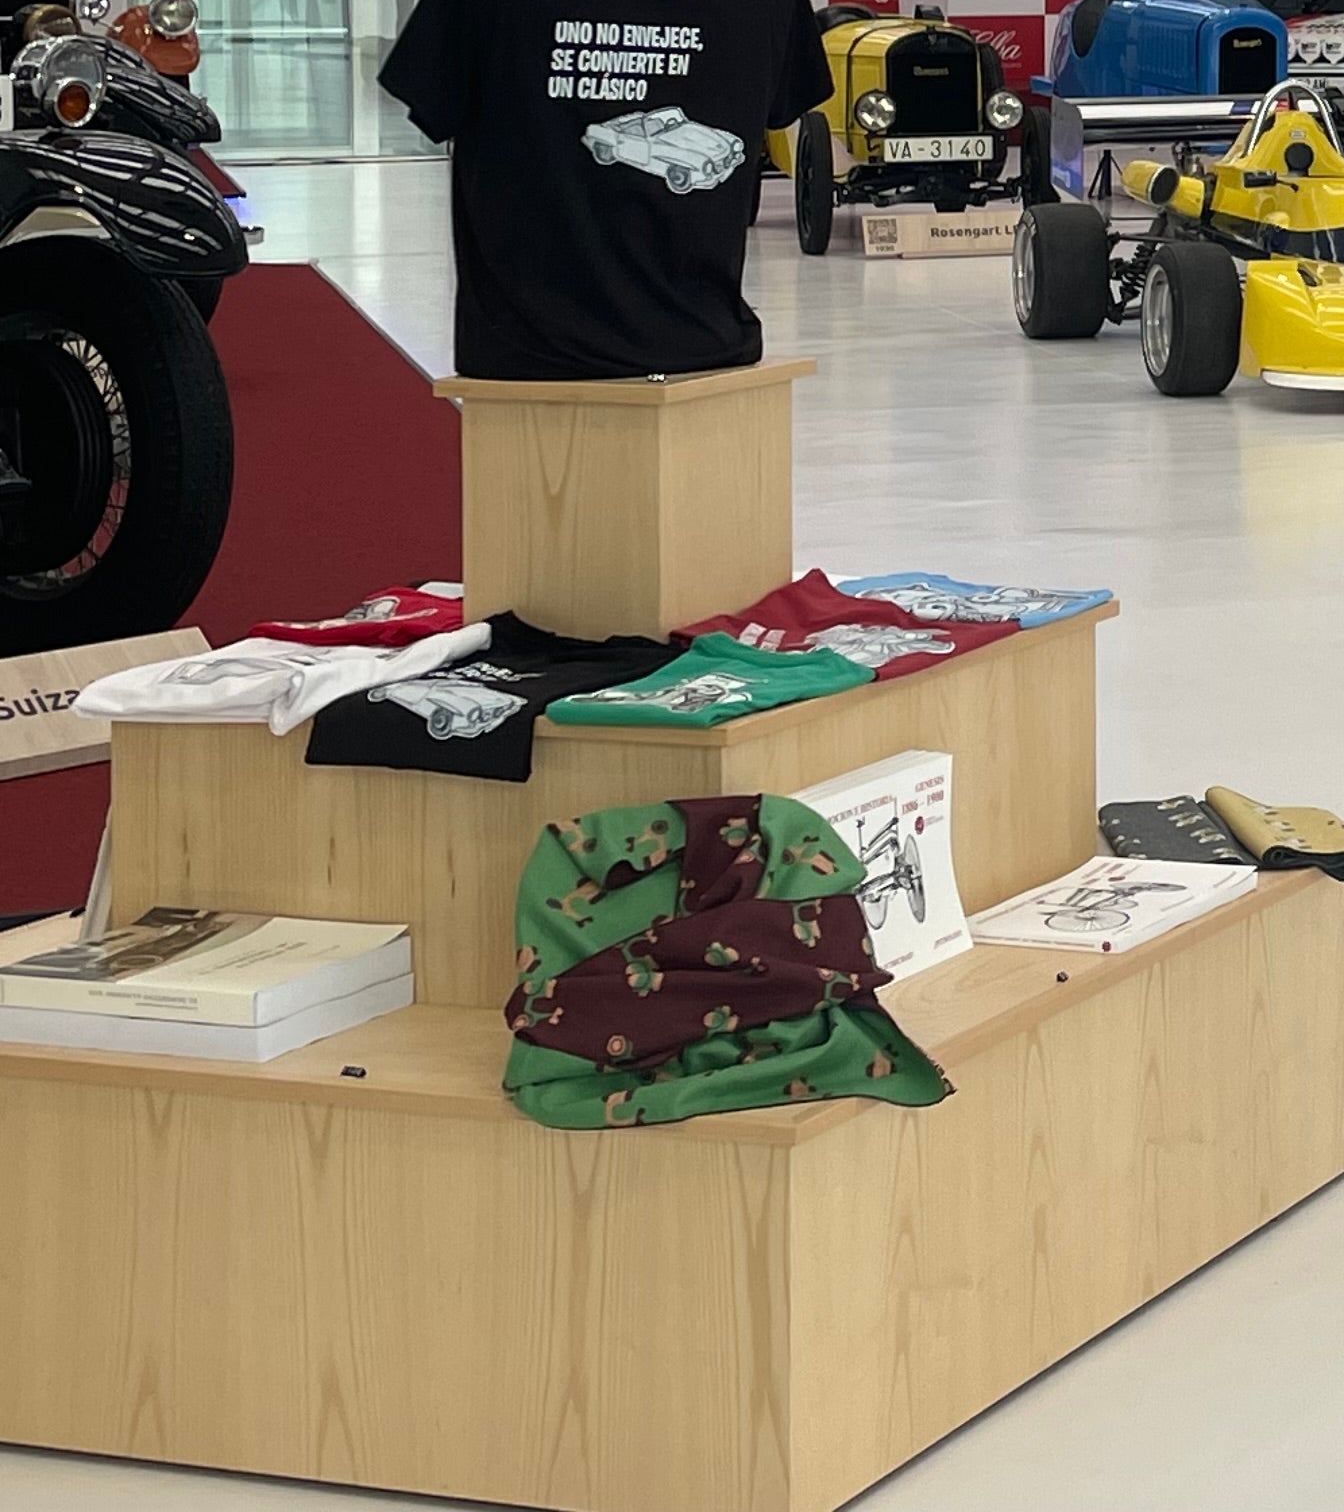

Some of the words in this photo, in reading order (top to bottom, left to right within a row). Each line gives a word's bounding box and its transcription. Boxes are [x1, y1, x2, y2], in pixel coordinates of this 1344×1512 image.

[555, 21, 593, 44] UNO
[596, 23, 620, 45] NO
[623, 24, 704, 51] ENVEJECE,
[551, 48, 575, 71] SE
[577, 50, 666, 74] CONVIERTE
[668, 53, 690, 76] EN
[548, 76, 575, 98] UN
[577, 72, 648, 101] CLÁSICO
[888, 139, 986, 159] VA-3140
[930, 223, 1001, 238] Rosengart
